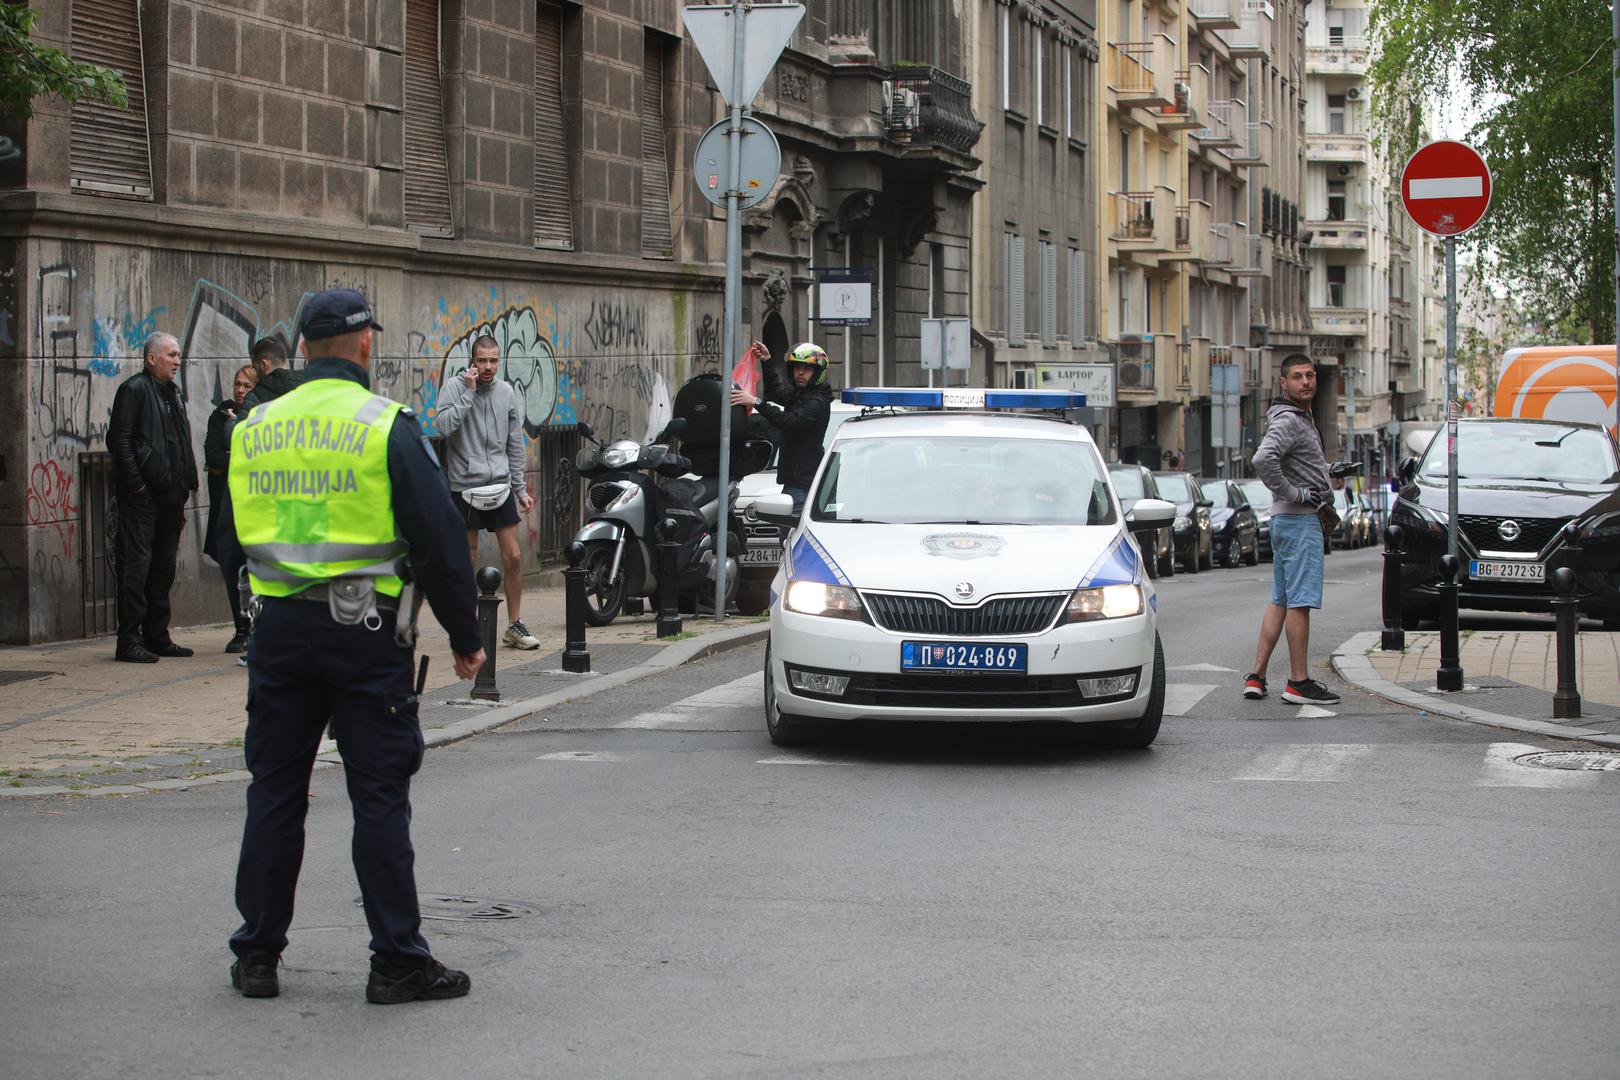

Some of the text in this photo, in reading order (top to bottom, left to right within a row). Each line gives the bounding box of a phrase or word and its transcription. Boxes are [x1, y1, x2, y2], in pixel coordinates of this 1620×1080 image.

[1057, 370, 1094, 380] LAPTOP
[943, 394, 984, 405] ПОЛИЦИЈА
[242, 418, 369, 460] САОБРАЋАЈНА
[248, 468, 358, 498] ПОЛИЦИЈА
[1479, 563, 1492, 575] BG
[921, 645, 932, 665] П
